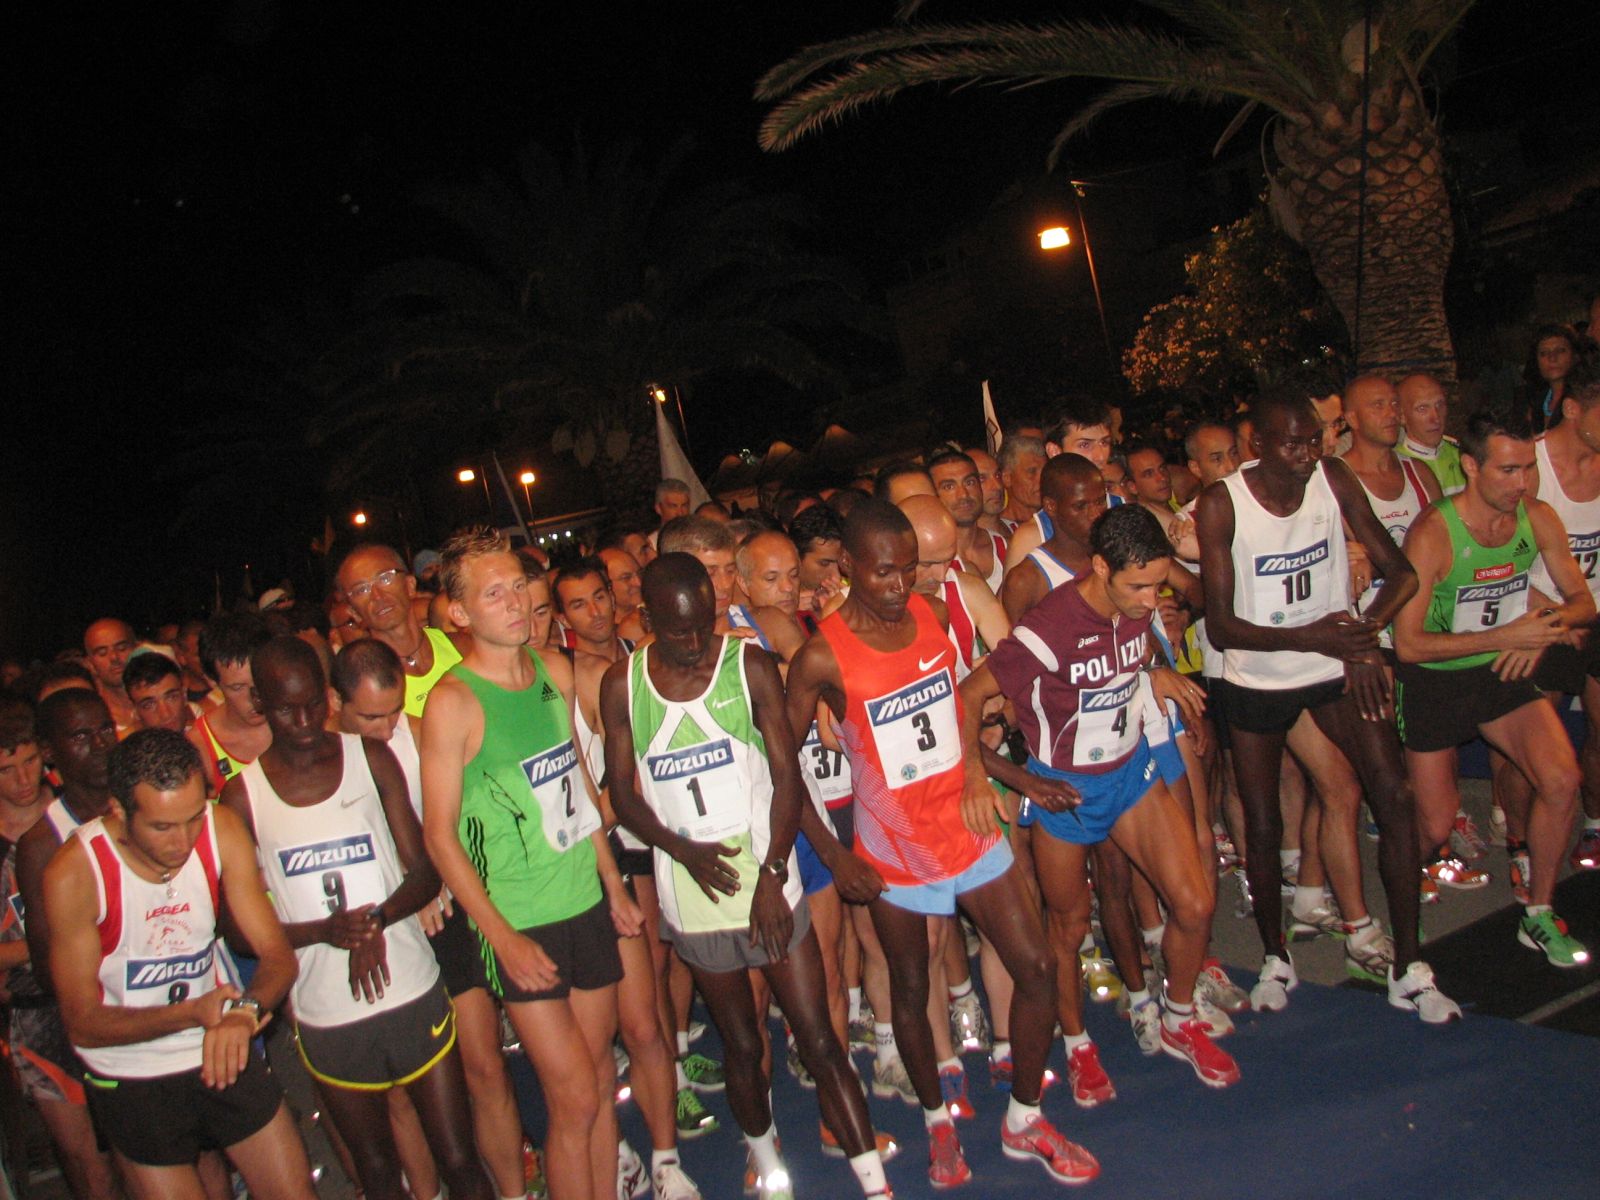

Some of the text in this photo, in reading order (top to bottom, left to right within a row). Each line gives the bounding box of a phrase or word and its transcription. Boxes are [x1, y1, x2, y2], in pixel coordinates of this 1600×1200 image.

[1259, 547, 1327, 572] MIZUNO
[1282, 569, 1311, 605] 10
[1461, 579, 1524, 600] MIZUNO
[1481, 600, 1500, 626] 5
[876, 680, 948, 721] MIZUNO
[911, 711, 937, 752] 3
[1111, 705, 1128, 738] 4
[654, 747, 728, 777] MIZUNO
[561, 775, 576, 818] 2
[686, 776, 707, 817] 1
[286, 842, 370, 873] MIZUNO
[322, 870, 348, 914] 9
[146, 903, 191, 920] LEGEA
